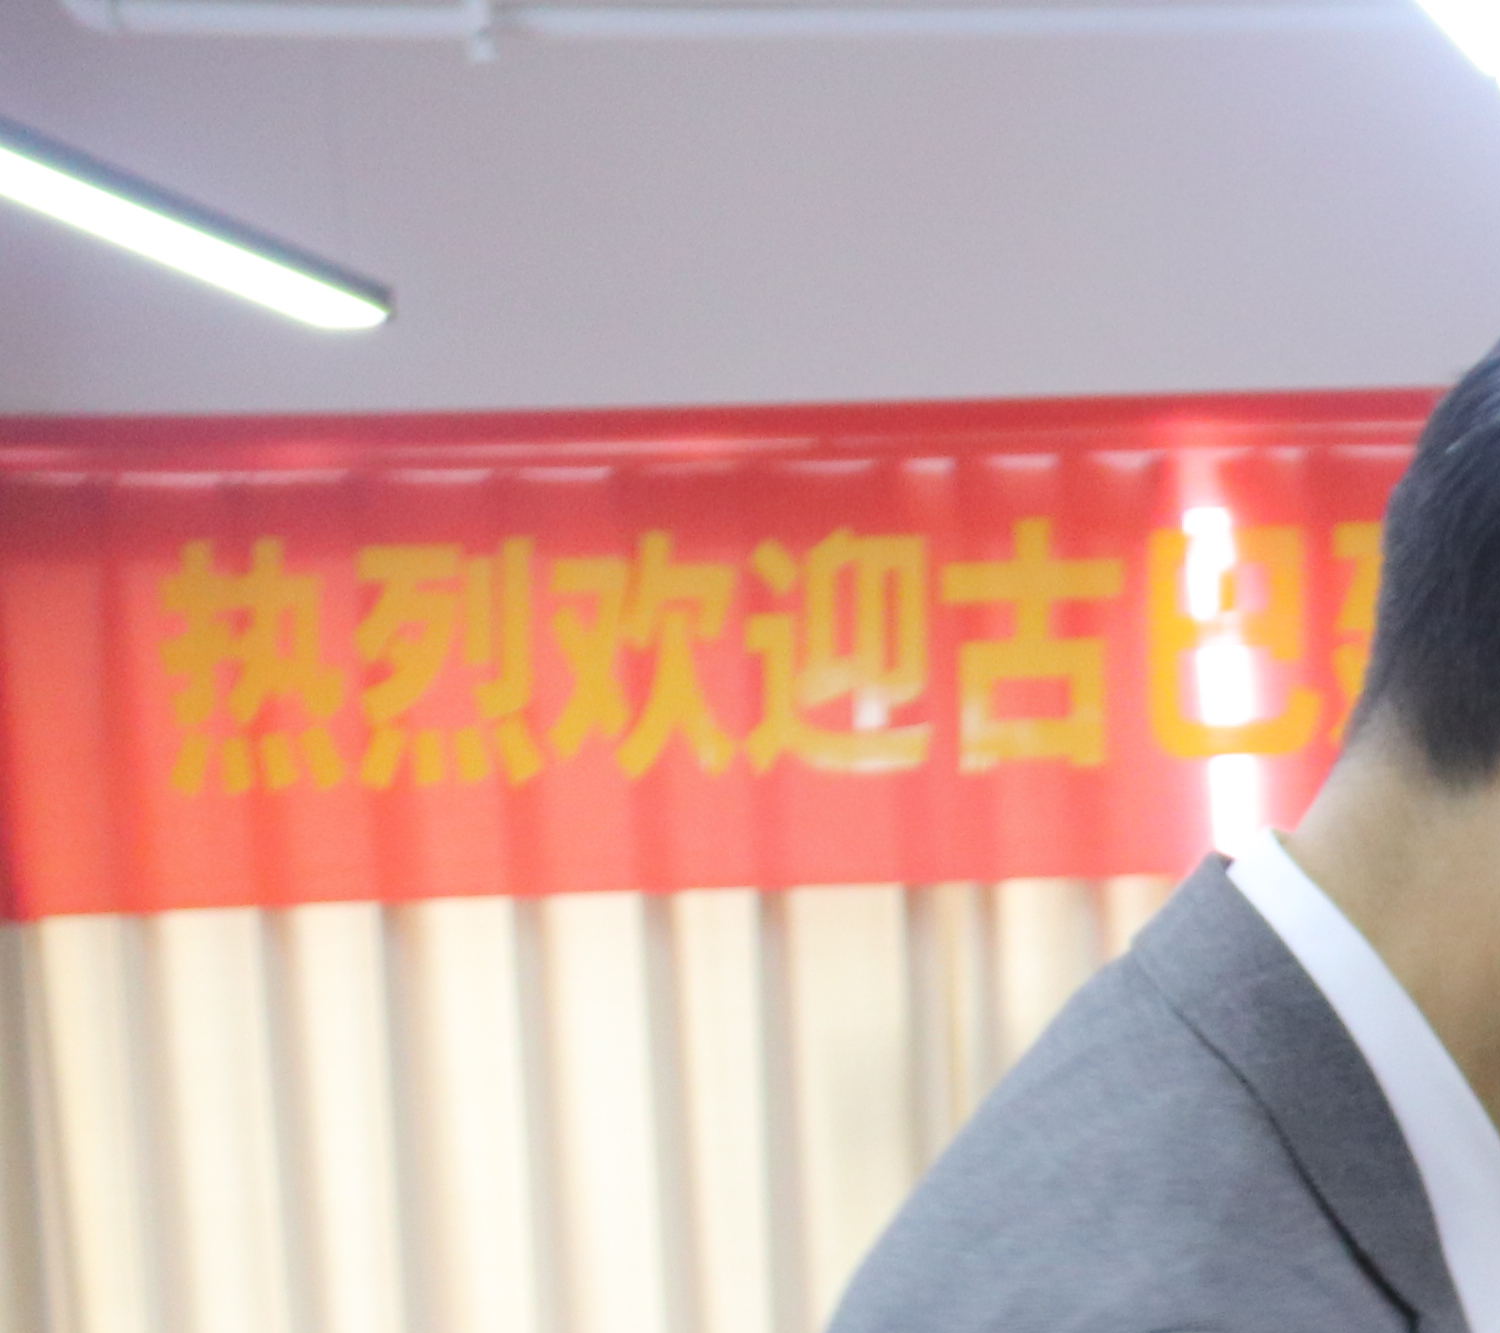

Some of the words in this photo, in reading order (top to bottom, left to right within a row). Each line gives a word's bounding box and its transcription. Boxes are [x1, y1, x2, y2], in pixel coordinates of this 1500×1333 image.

[158, 516, 1384, 796] 热烈欢迎古巴
